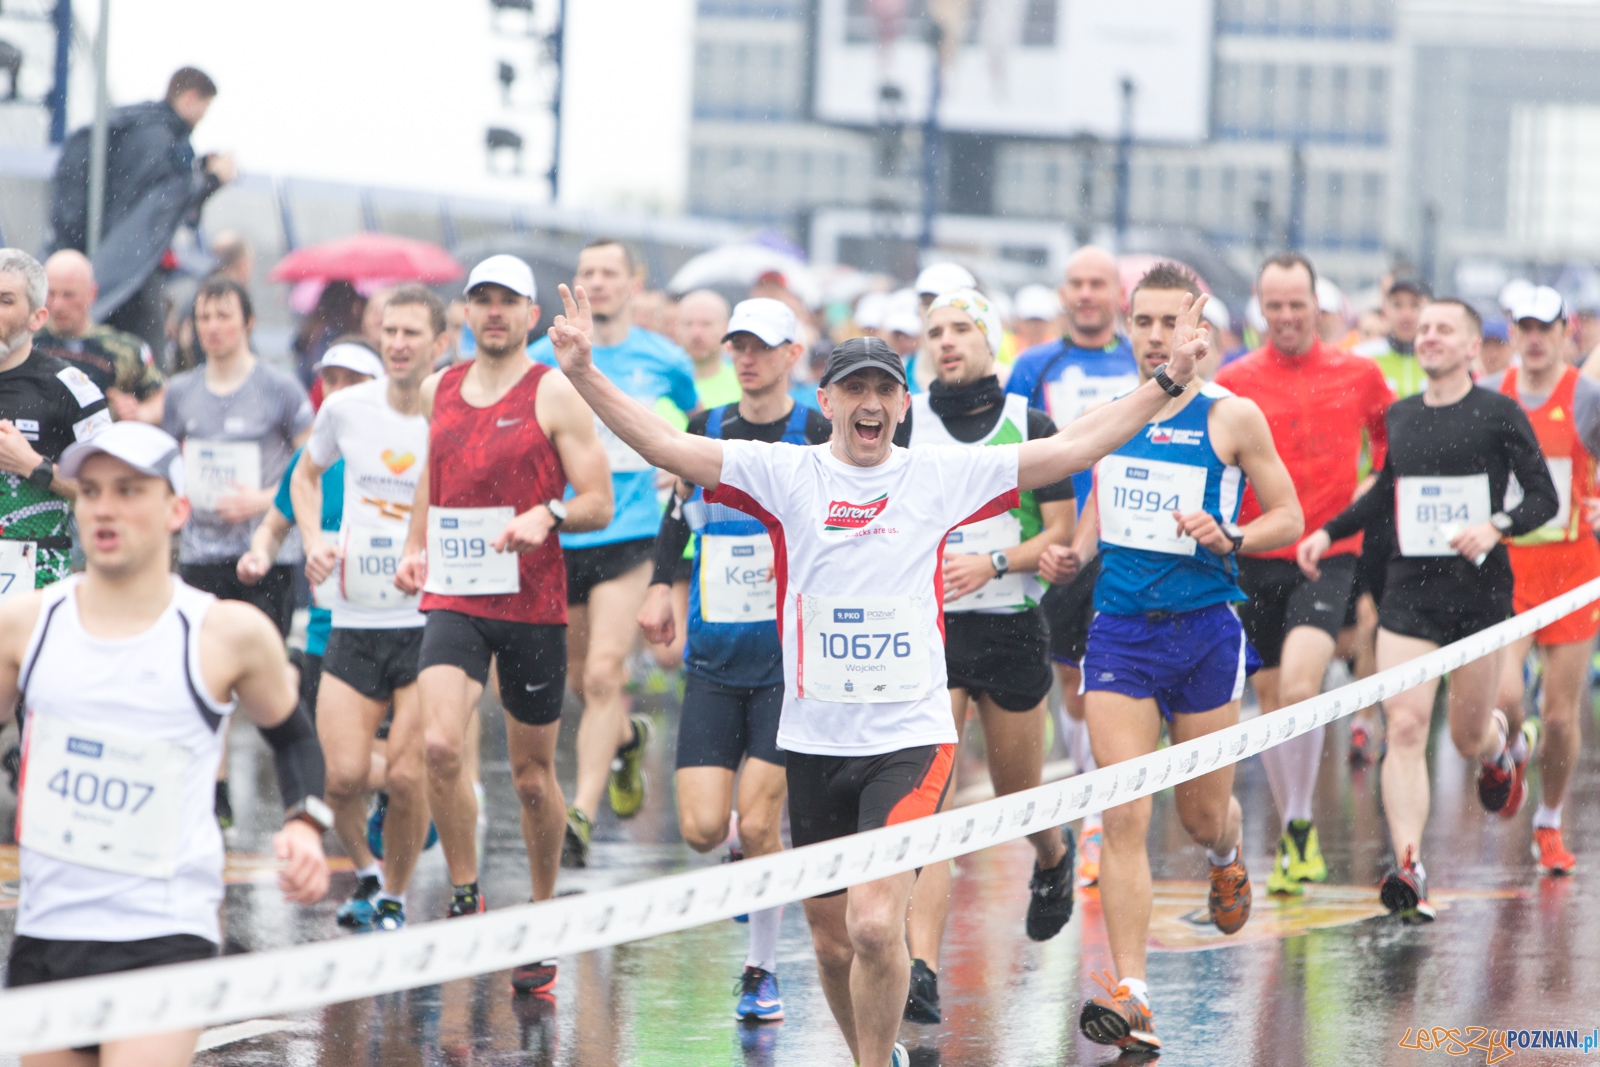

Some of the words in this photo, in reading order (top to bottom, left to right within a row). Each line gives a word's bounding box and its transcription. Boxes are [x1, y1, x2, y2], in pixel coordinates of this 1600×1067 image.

[1113, 486, 1181, 512] 11994
[829, 503, 877, 519] Lorenz
[1416, 503, 1469, 523] 8134
[440, 537, 486, 558] 1919
[358, 555, 402, 576] 108
[820, 632, 911, 659] 10676
[845, 664, 886, 673] Wojciech
[47, 766, 155, 815] 4007
